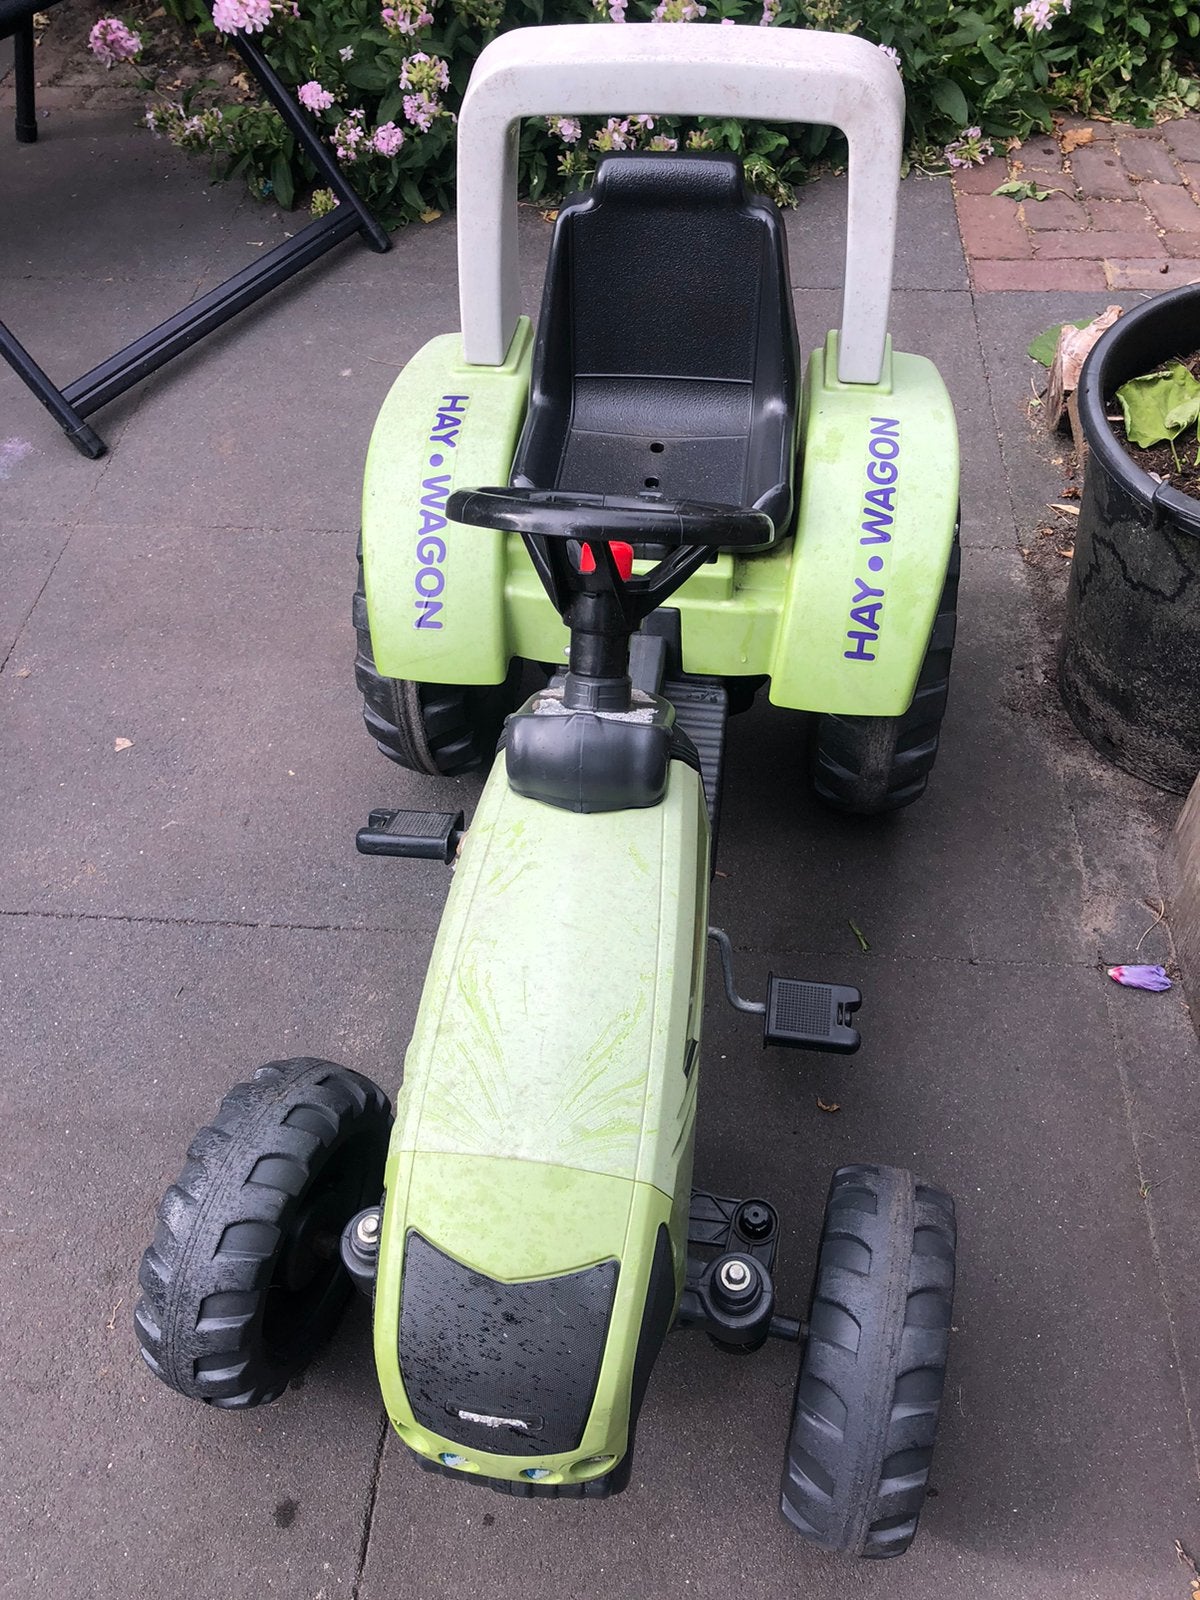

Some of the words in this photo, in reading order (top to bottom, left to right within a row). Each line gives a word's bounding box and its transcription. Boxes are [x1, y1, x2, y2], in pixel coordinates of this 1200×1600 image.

[429, 395, 470, 448] HAY
[859, 416, 900, 546] WAGON
[413, 474, 452, 630] WAGON
[843, 577, 885, 661] HAY
